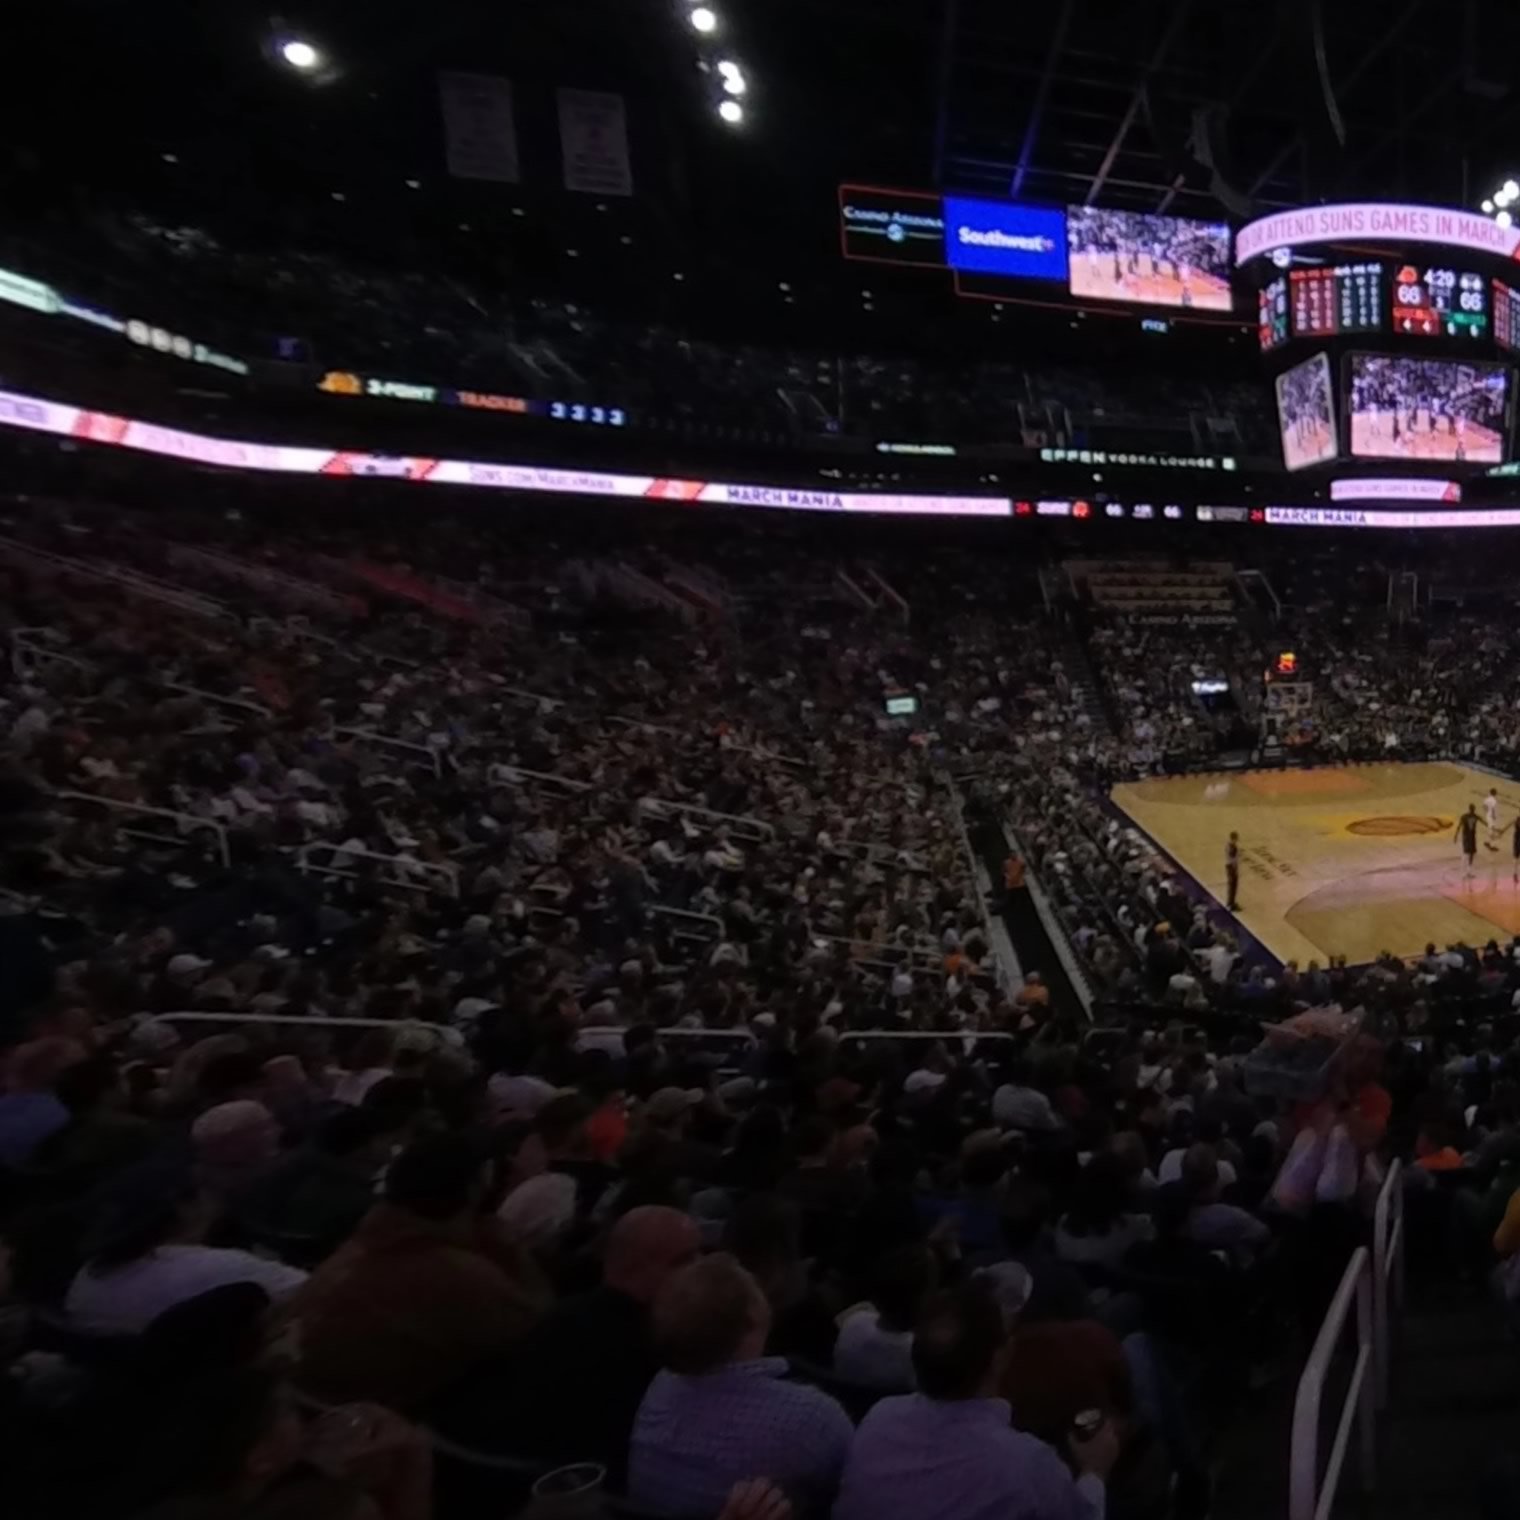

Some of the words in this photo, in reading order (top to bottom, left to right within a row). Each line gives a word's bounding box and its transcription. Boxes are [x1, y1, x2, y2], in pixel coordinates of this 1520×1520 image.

[958, 226, 1043, 252] Southwest
[1267, 214, 1313, 242] ATTEND
[1320, 211, 1364, 233] SUNS
[1370, 209, 1429, 234] GAMES
[1436, 215, 1452, 235] IN
[1459, 219, 1505, 247] MARCH
[367, 379, 437, 403] 3-POINT
[457, 391, 527, 412] TRACKER
[551, 402, 565, 420] 3
[570, 404, 585, 421] 3
[590, 406, 605, 423] 3
[609, 408, 625, 426] 3
[1041, 449, 1105, 464] EFFEN
[728, 487, 783, 503] MARCH
[788, 491, 843, 508] MANIA
[1270, 510, 1318, 522] MARCH
[1323, 512, 1366, 523] MANIA
